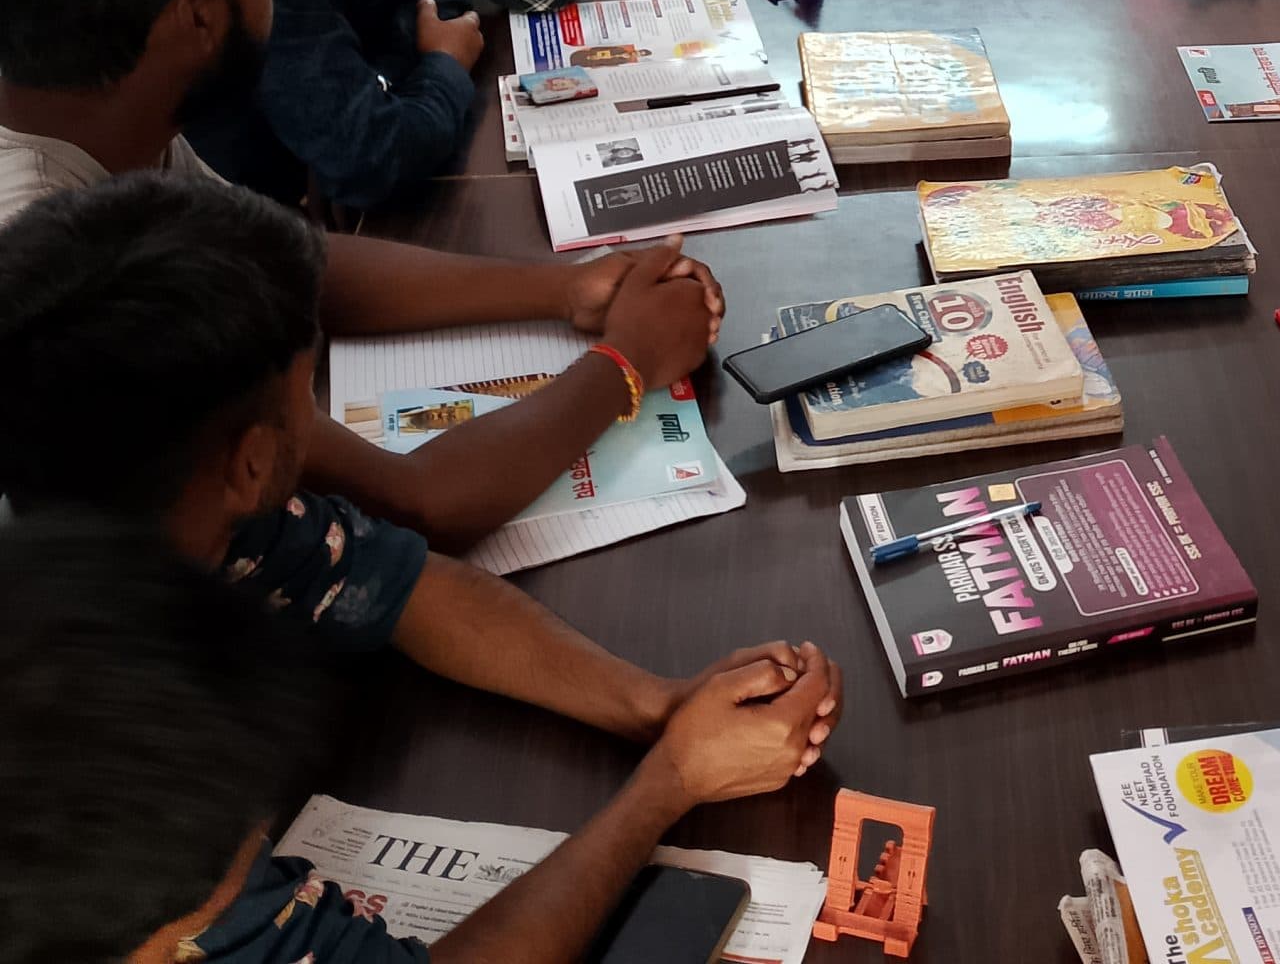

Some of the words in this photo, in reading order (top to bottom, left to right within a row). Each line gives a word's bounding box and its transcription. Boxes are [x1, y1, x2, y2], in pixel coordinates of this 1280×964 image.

[911, 294, 925, 310] New
[933, 295, 974, 330] 10
[995, 276, 1045, 333] English
[656, 412, 690, 443] प्रगति
[869, 505, 887, 535] EDITION
[936, 487, 1044, 636] FATMAN
[1016, 537, 1038, 562] THEORY
[938, 552, 981, 603] PARMAR
[1002, 647, 1052, 668] FATMAN
[1197, 756, 1232, 806] DREAM
[1219, 752, 1239, 778] TRUE
[1121, 784, 1134, 801] JEE
[1133, 779, 1149, 807] NEET
[1140, 761, 1164, 811] OLYMPIAD
[1152, 755, 1180, 818] FOUNDATION
[1227, 776, 1247, 803] COME
[369, 833, 480, 882] THE
[1242, 912, 1270, 950] DIVISION
